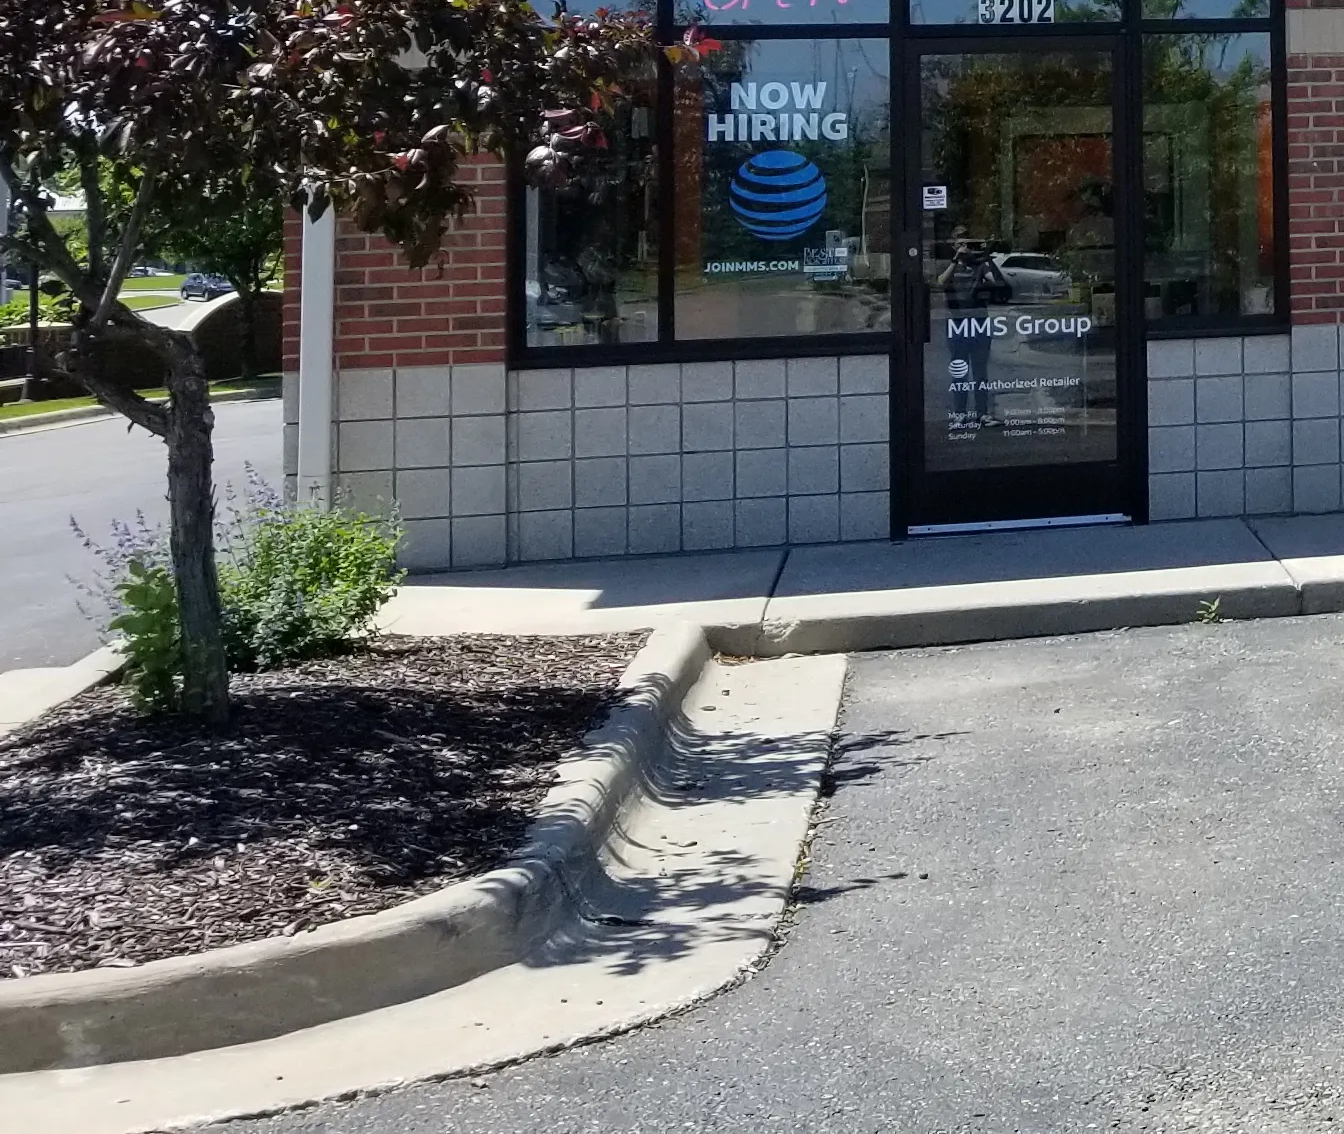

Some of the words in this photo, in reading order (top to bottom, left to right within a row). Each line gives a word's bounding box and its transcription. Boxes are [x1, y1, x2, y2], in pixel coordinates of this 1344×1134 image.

[729, 81, 828, 110] NOW
[707, 112, 849, 142] HIRING
[703, 260, 799, 273] JOINMMS.COM
[947, 316, 1008, 339] MMS
[1015, 315, 1092, 338] Group
[948, 381, 977, 392] AT&T
[978, 377, 1037, 391] Authorized
[1039, 376, 1081, 388] Retailer
[948, 421, 982, 430] Saturday
[948, 432, 977, 441] Sunday
